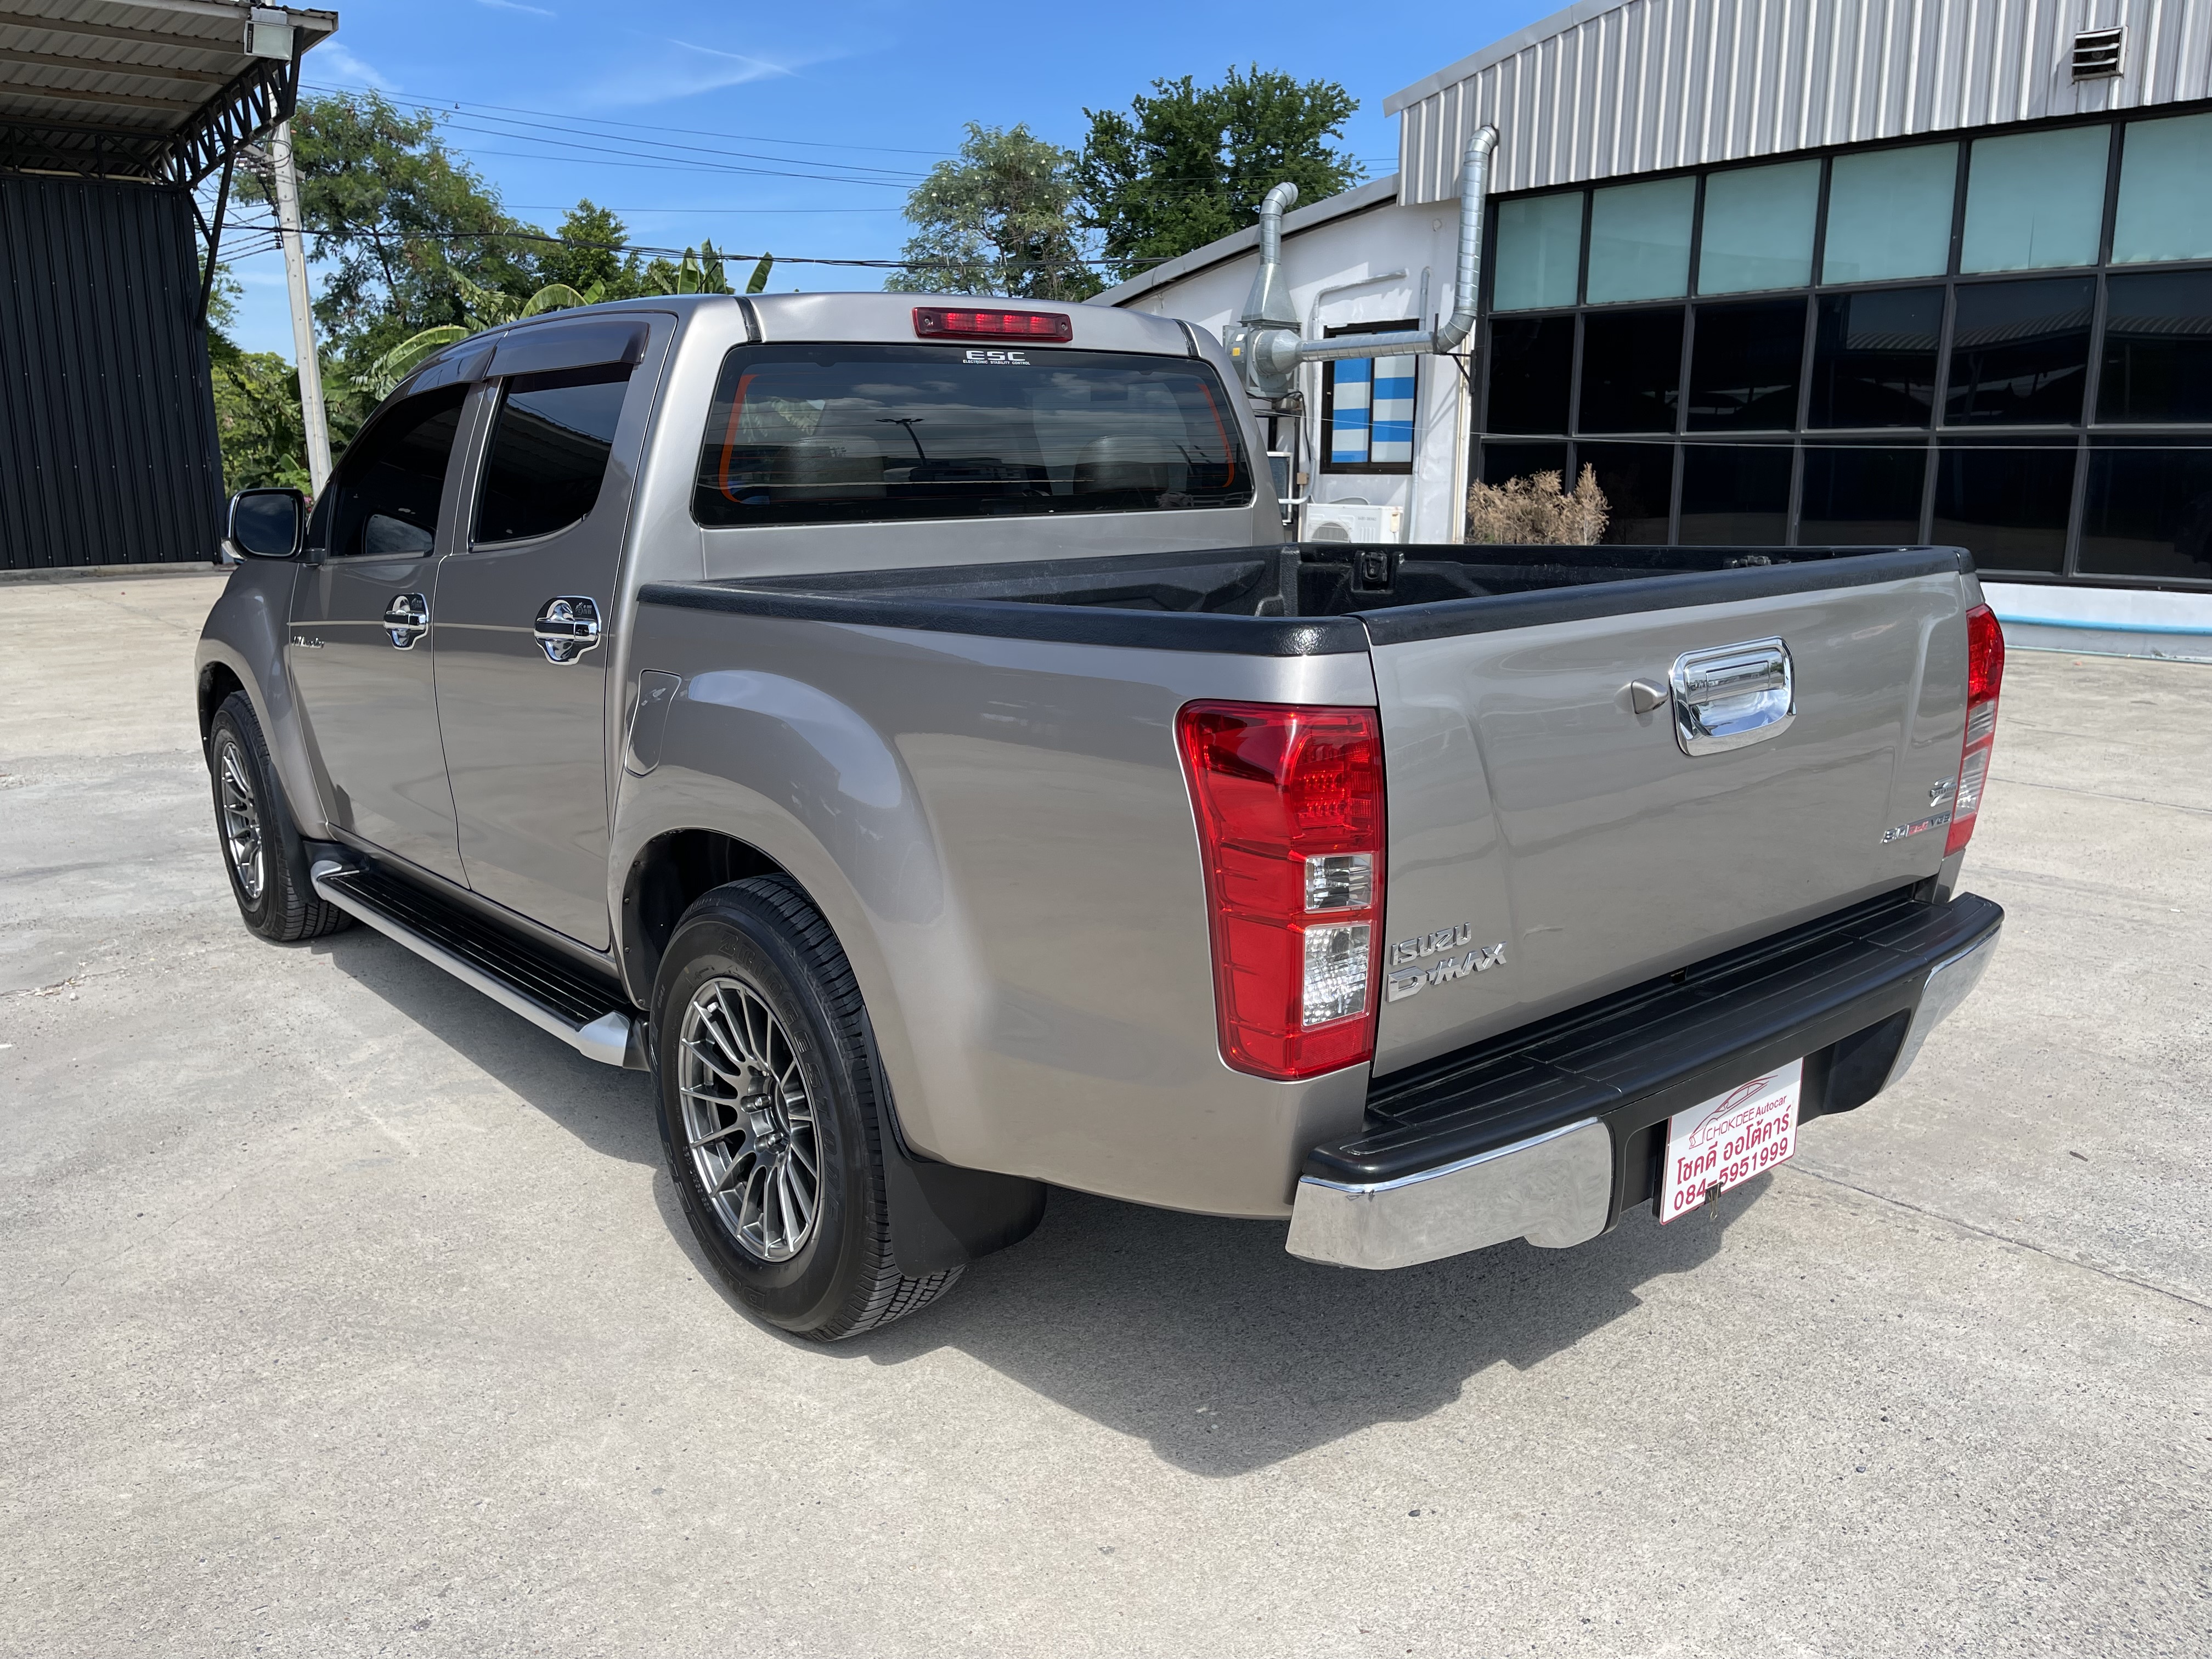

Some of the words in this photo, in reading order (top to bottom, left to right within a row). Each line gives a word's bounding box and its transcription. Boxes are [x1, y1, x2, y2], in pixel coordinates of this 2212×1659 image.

[966, 350, 1026, 361] ESC
[1386, 940, 1508, 1003] D-MAX
[1390, 922, 1472, 966] ISUZU
[718, 930, 840, 1224] BRIDGESTONE
[1677, 1141, 1718, 1186] โชคดี
[1723, 1104, 1791, 1161] ออโต้คาร์
[1706, 1107, 1755, 1142] CHOKDEE
[1755, 1094, 1787, 1118] Autocar
[1674, 1137, 1788, 1211] 084-5951999
